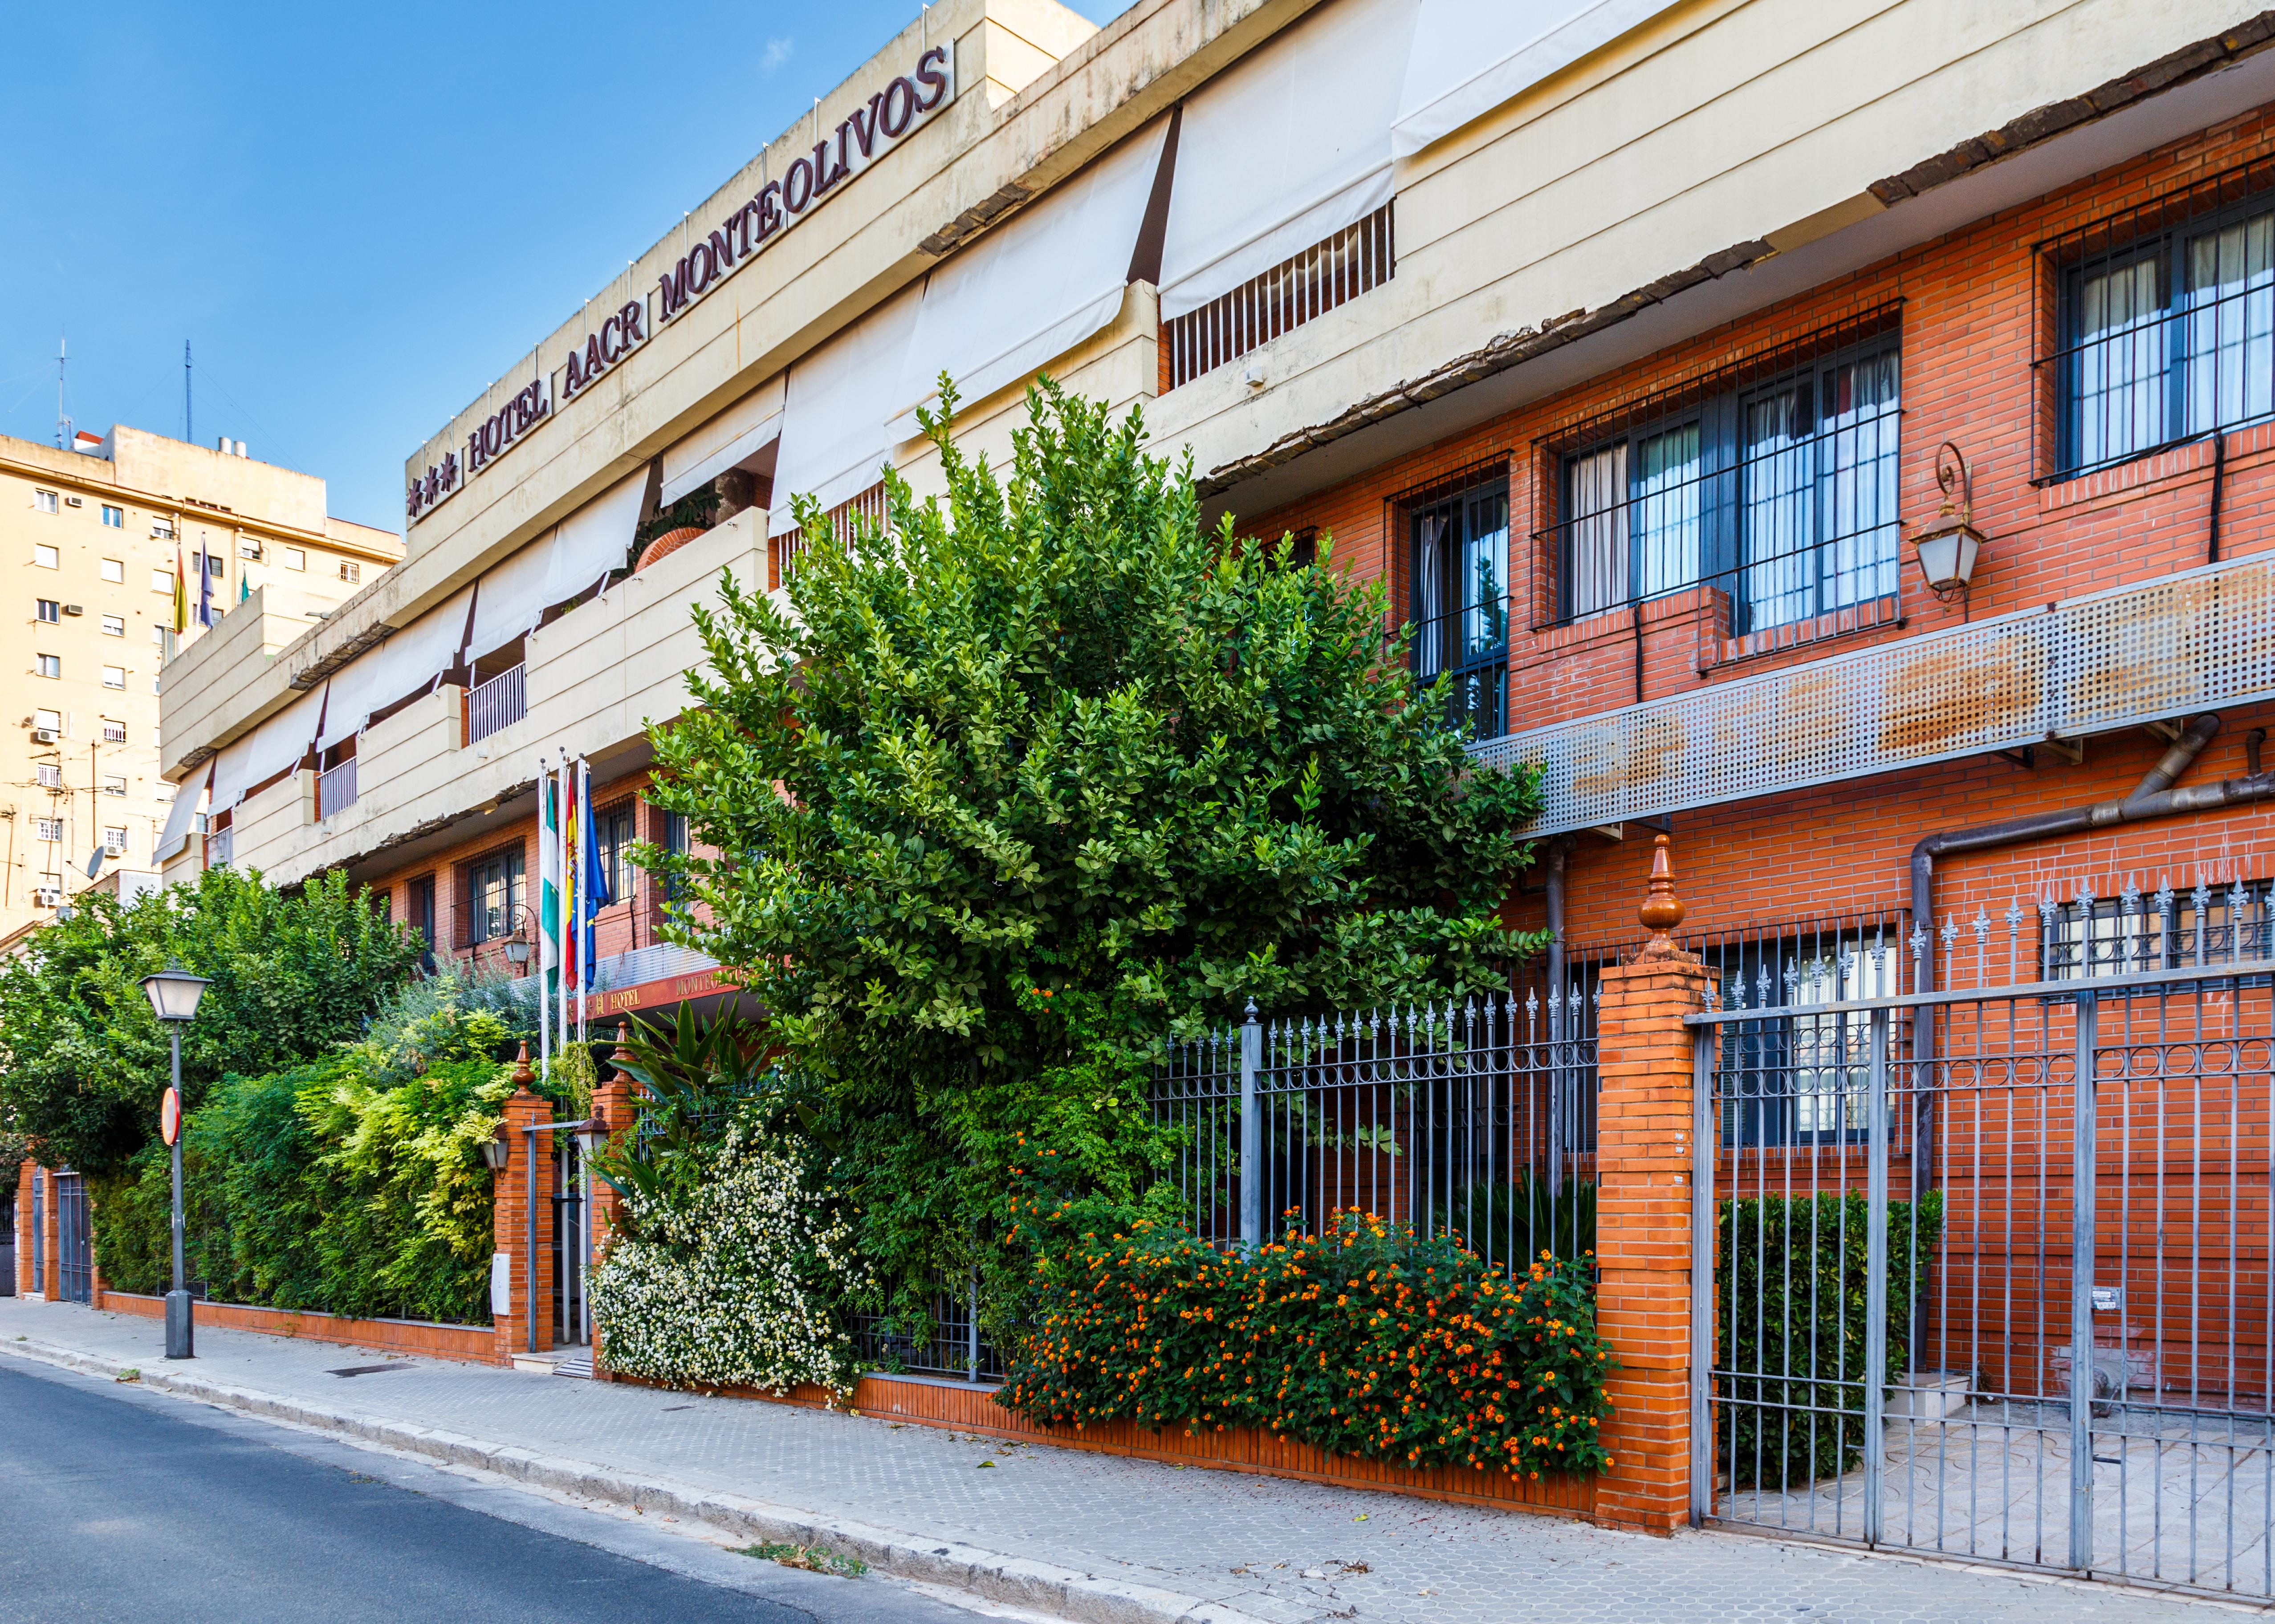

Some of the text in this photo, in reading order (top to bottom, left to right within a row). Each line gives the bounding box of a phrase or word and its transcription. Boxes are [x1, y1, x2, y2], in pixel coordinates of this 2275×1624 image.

[468, 46, 946, 472] HOTEL AACR MONTEOLIVOS
[611, 989, 640, 1010] HOTEL
